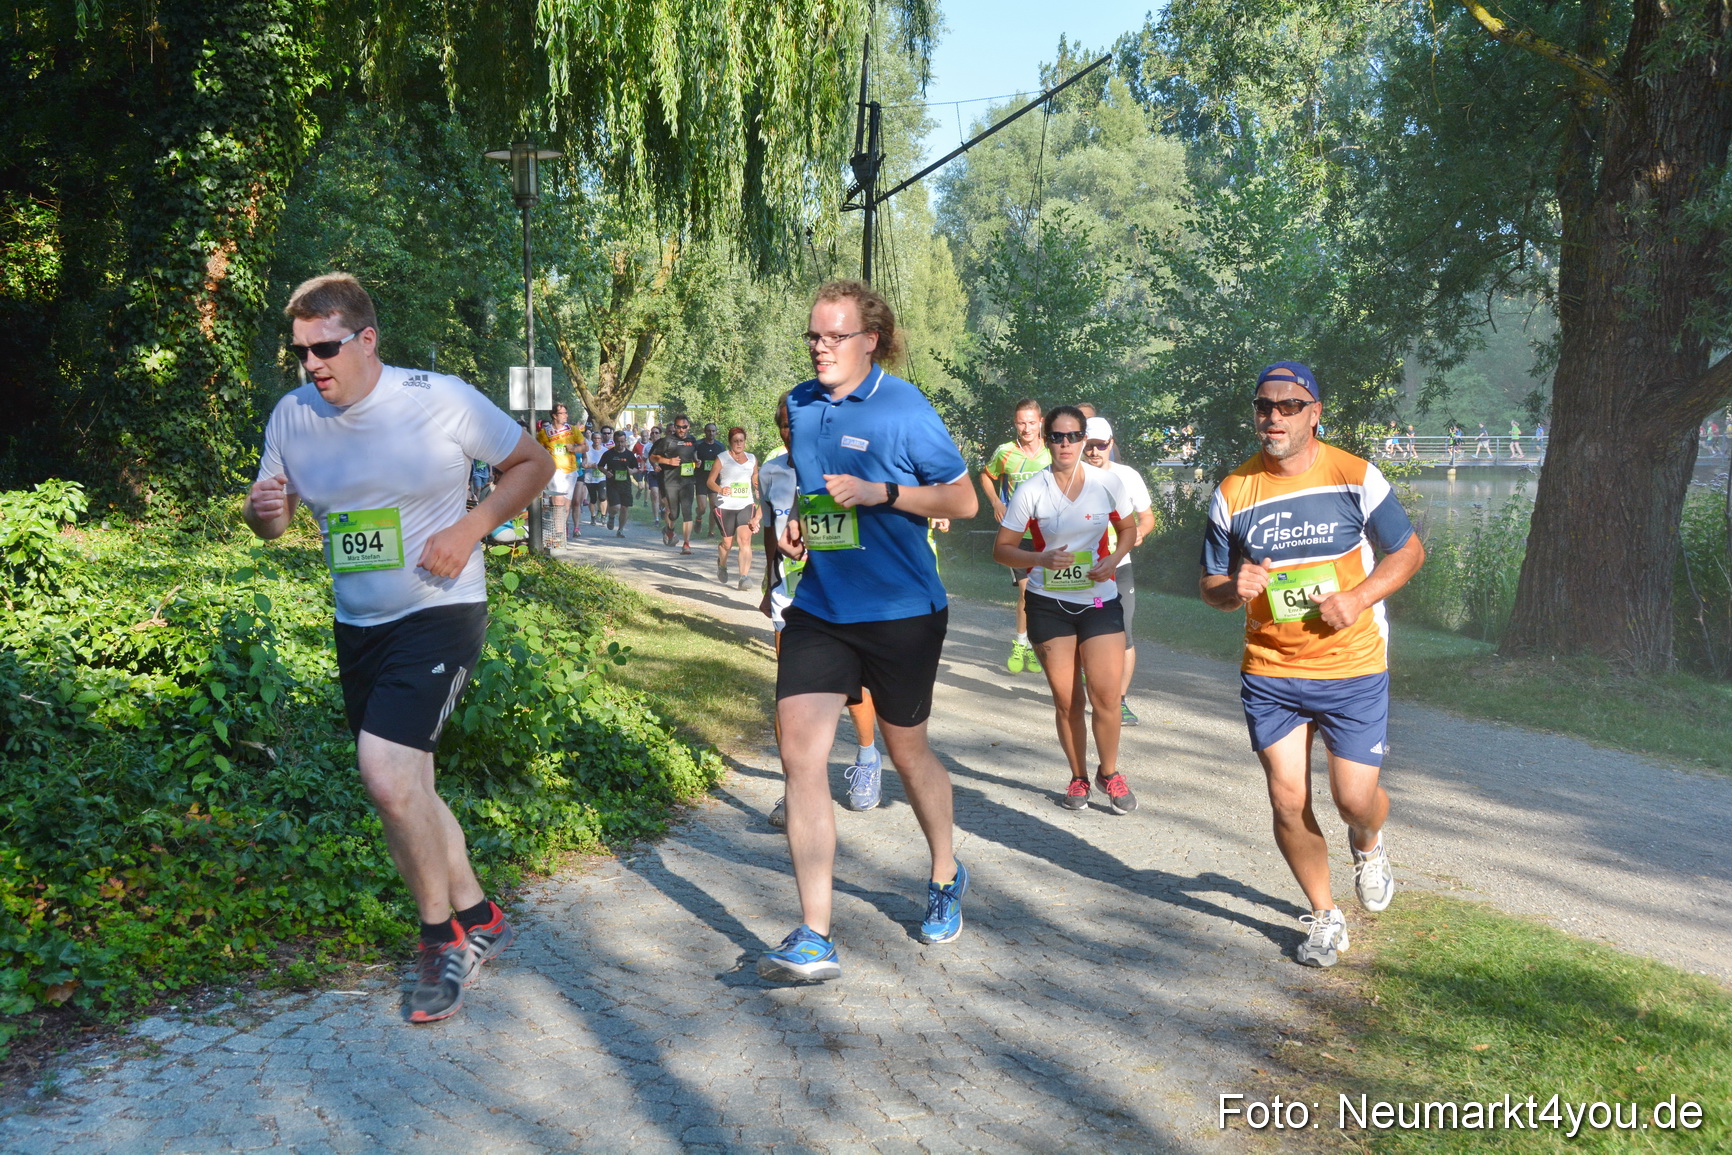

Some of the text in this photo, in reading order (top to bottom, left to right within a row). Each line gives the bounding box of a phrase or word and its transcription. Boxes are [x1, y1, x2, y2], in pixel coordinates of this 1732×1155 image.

[402, 380, 432, 390] adidas
[803, 513, 846, 534] 1517
[1263, 521, 1339, 544] Fischer
[342, 531, 384, 555] 694
[1271, 536, 1334, 551] AUTOMOBILE
[1053, 565, 1082, 580] 246
